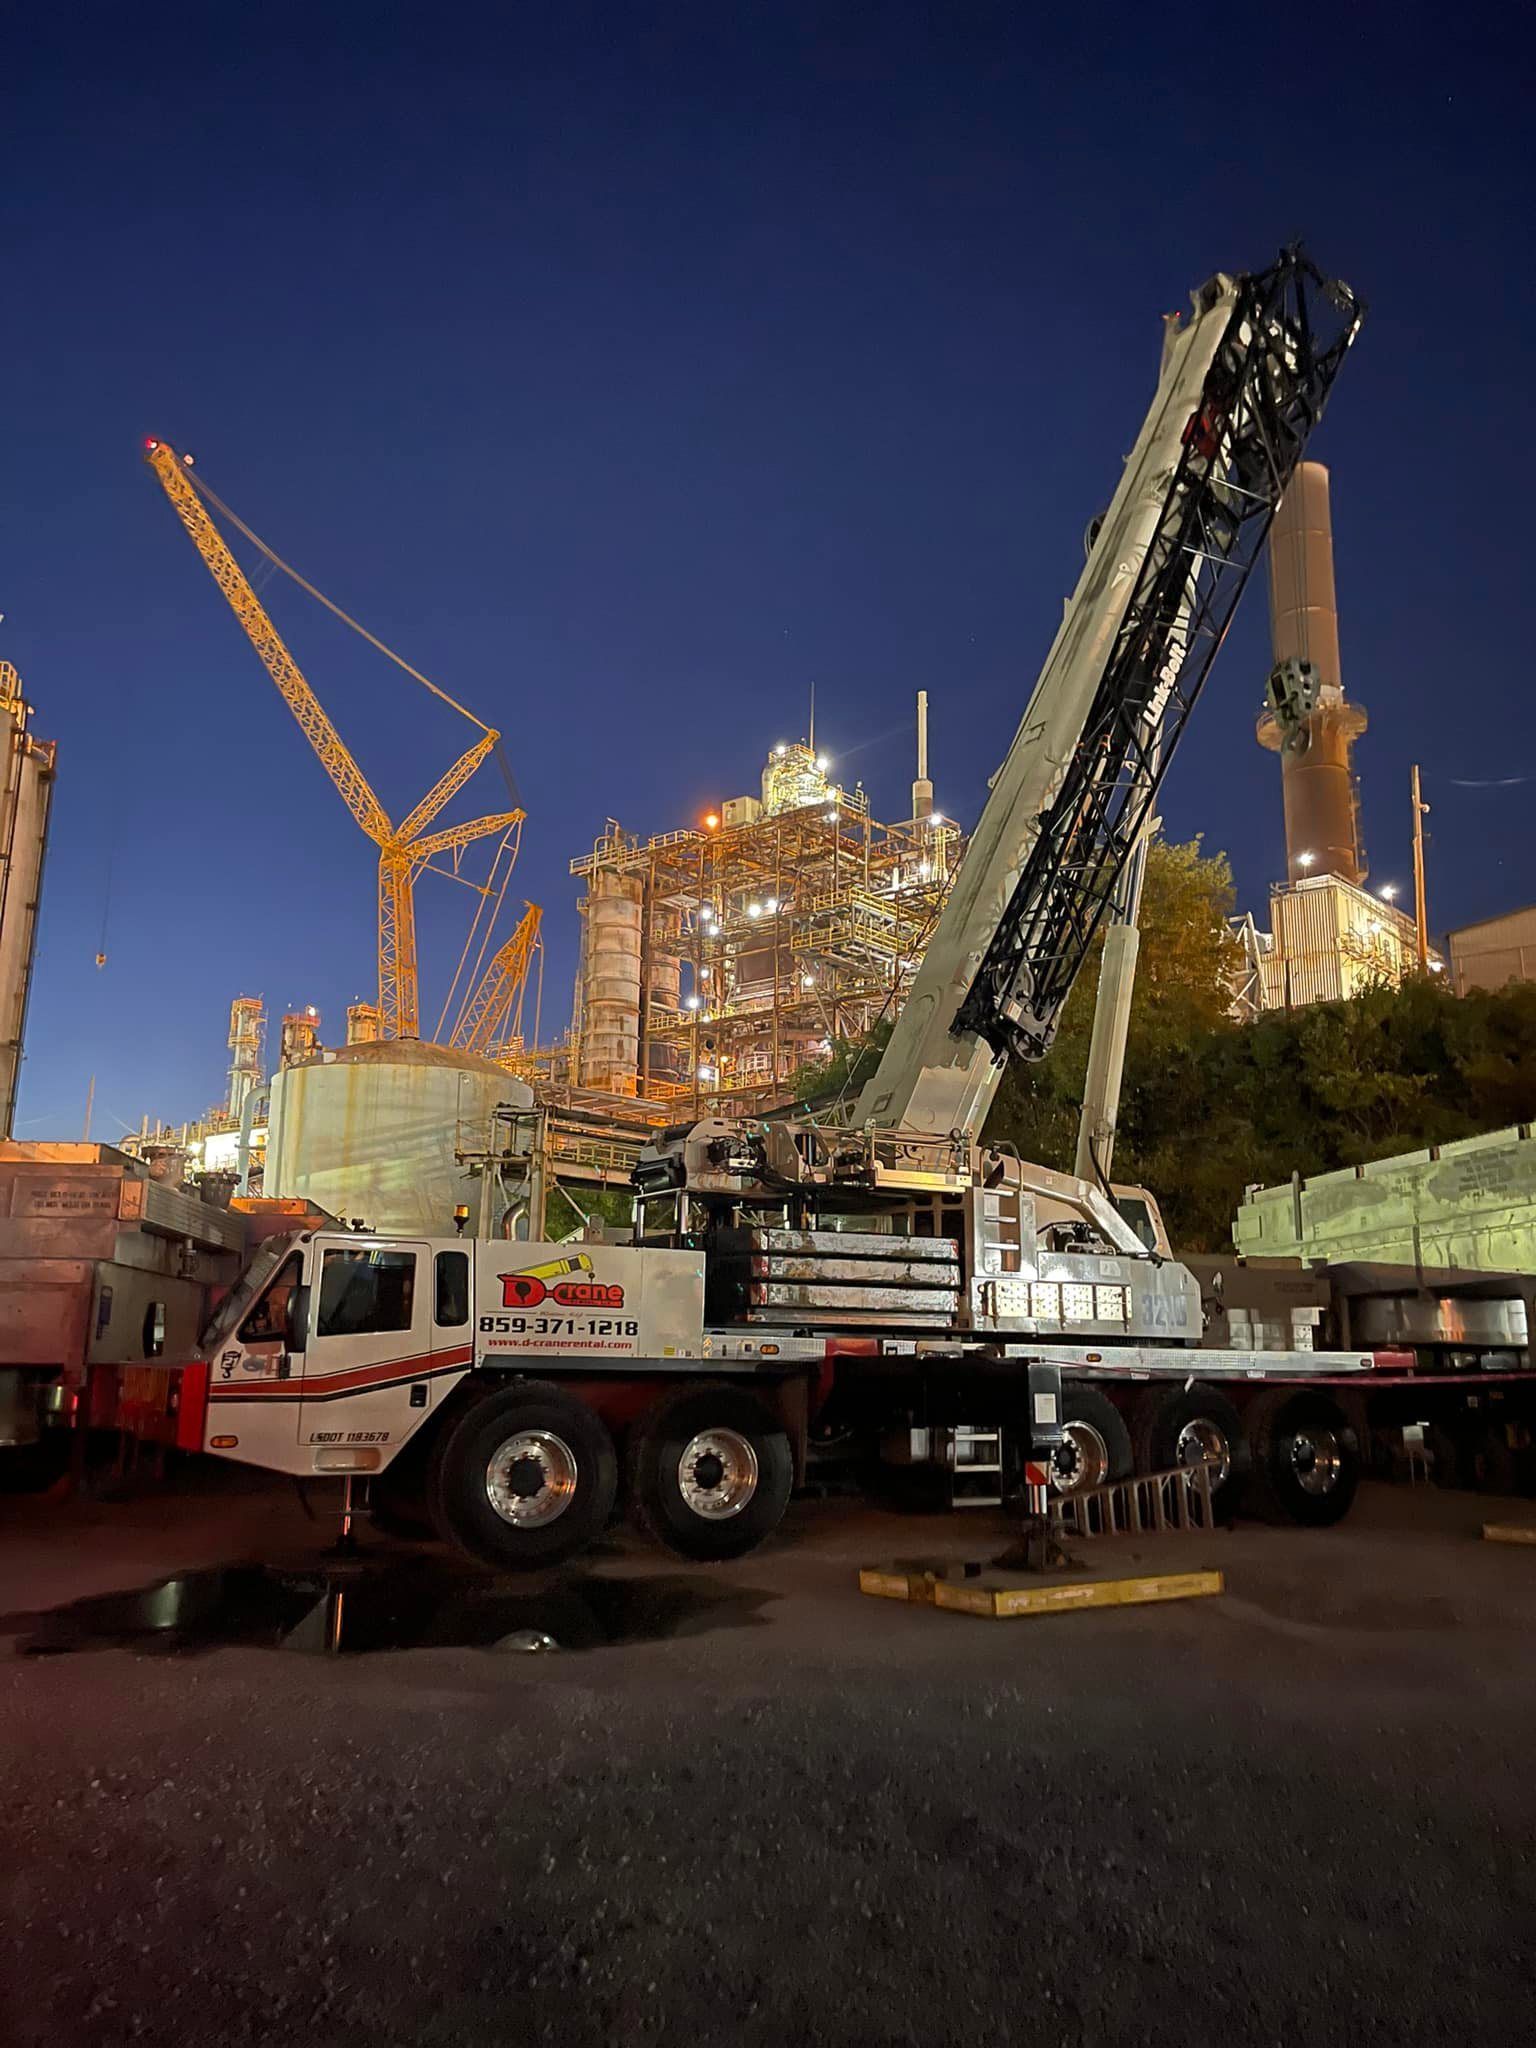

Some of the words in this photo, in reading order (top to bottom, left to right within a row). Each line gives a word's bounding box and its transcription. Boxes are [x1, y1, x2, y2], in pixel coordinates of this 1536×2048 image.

[1142, 642, 1187, 728] Link-Belt
[479, 1316, 639, 1336] 859-371-1218
[487, 1338, 633, 1350] www.d-cranerental.com
[346, 1431, 390, 1442] 1183678
